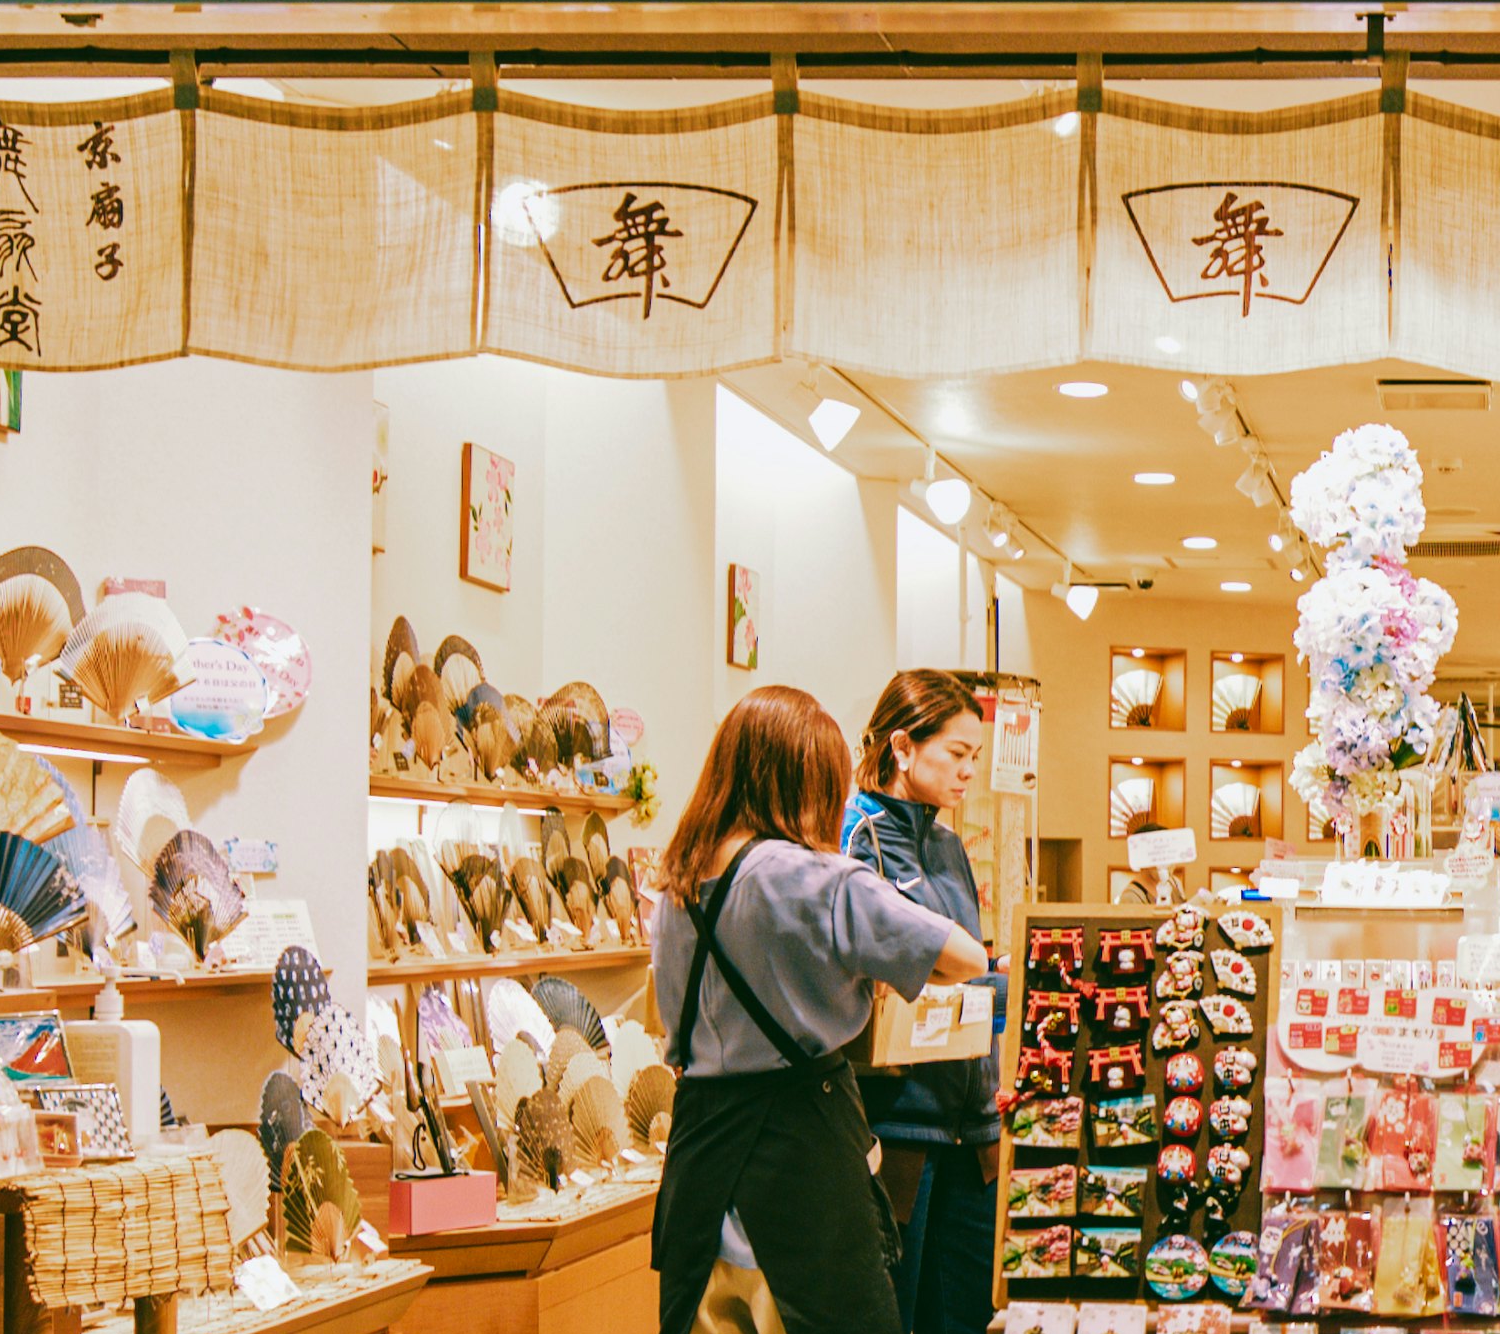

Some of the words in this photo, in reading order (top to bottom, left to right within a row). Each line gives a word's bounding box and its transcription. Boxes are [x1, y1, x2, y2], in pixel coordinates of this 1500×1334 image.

[76, 120, 124, 283] 京扇子
[592, 190, 684, 320] 舞
[1191, 190, 1284, 318] 舞
